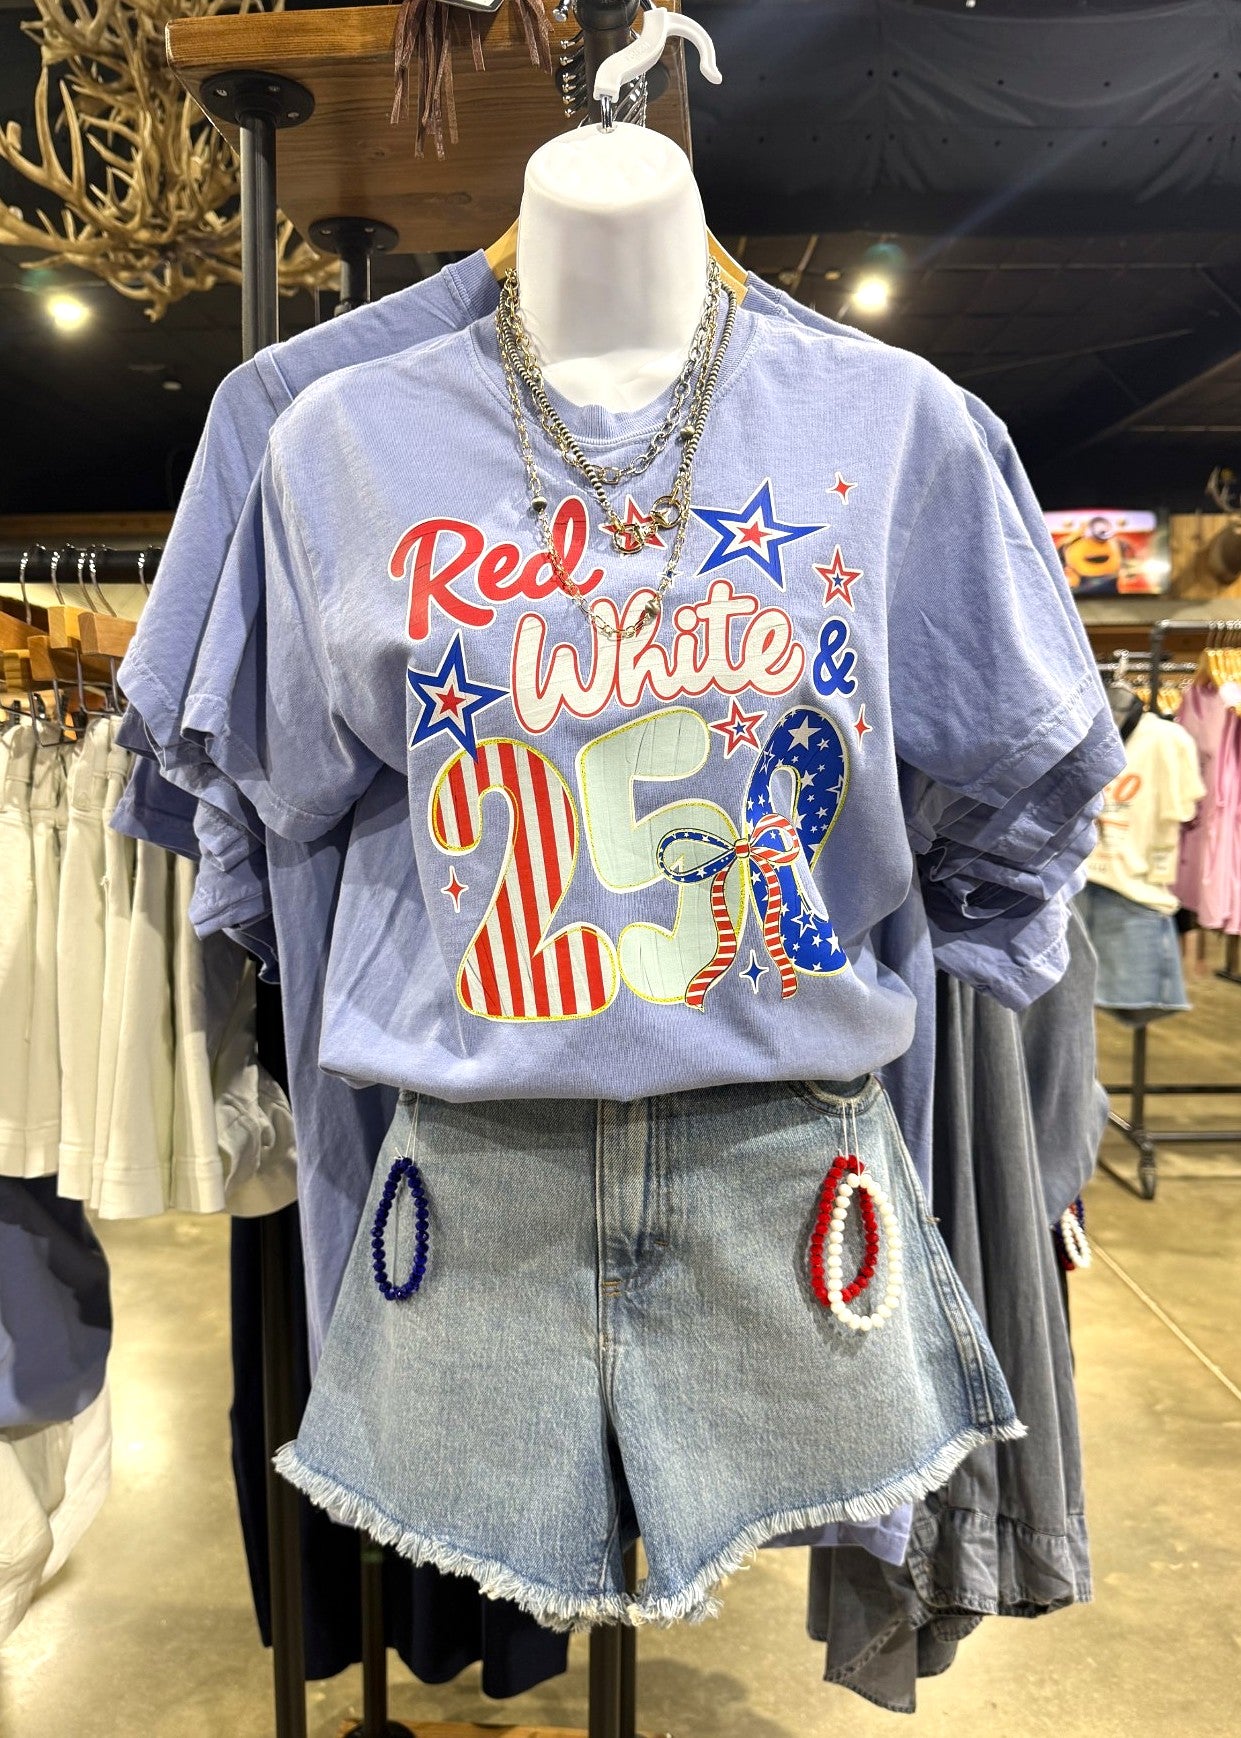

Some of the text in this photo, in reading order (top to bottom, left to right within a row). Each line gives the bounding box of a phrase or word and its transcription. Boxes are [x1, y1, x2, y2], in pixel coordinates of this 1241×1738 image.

[389, 498, 605, 640] Red
[511, 580, 858, 734] White &
[430, 707, 851, 1023] 250
